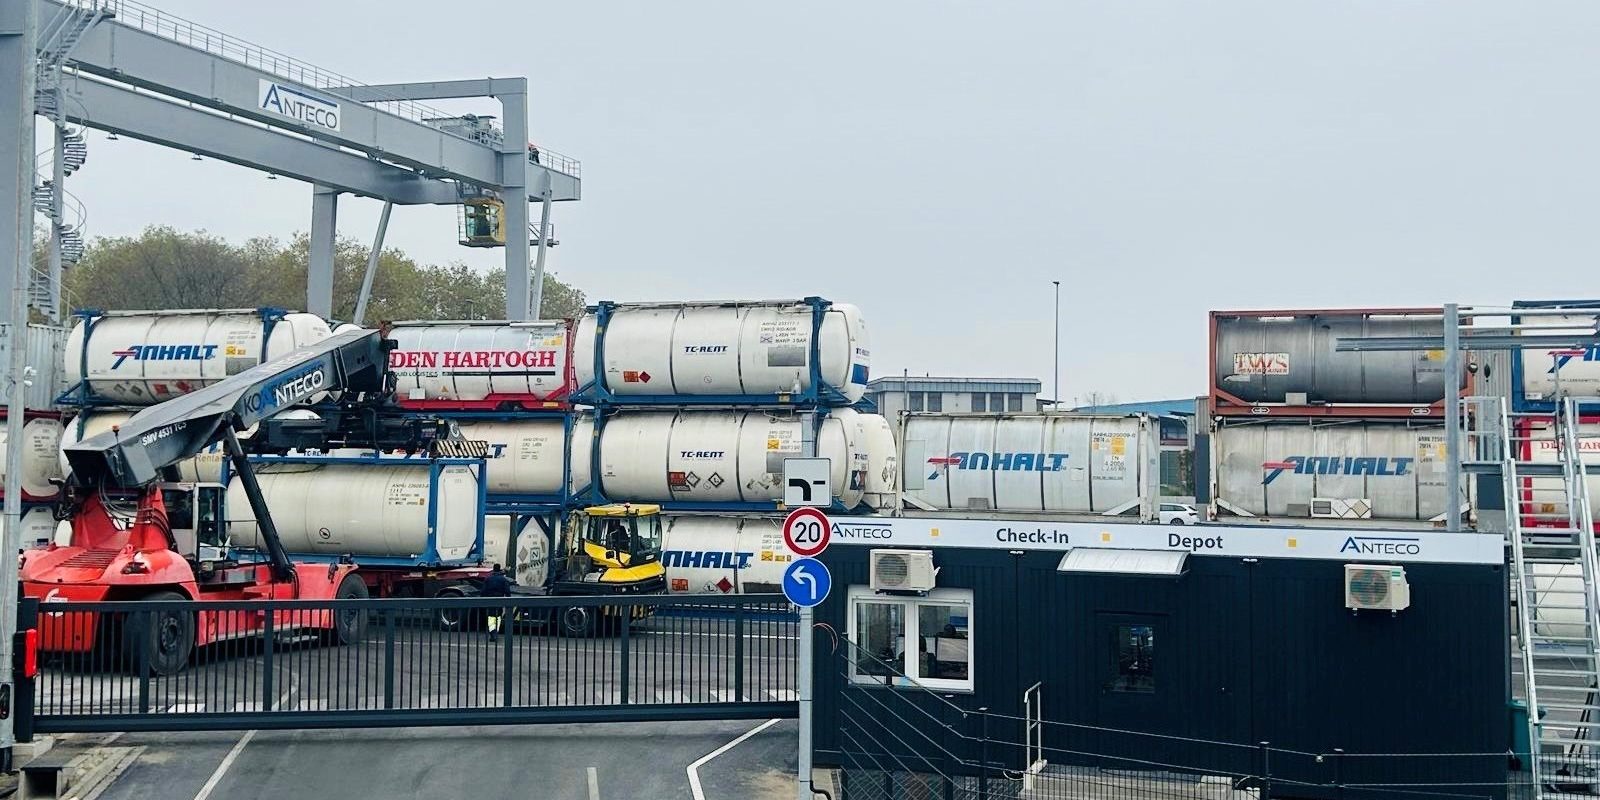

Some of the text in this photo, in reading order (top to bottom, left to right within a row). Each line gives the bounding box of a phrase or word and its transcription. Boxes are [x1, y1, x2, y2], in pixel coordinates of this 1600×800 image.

[262, 84, 337, 129] ANTECO
[111, 344, 218, 370] ANHALT
[391, 350, 556, 369] DEN HARTOGH
[685, 345, 728, 353] TC-RENT
[142, 431, 158, 447] SMV
[158, 426, 173, 439] 4531
[926, 452, 1069, 481] ANHALT
[1261, 455, 1414, 485] ANHALT
[794, 521, 821, 543] 20
[830, 522, 893, 539] ANTECO
[996, 527, 1069, 545] Check-In
[1168, 532, 1224, 552] Depot
[1339, 535, 1421, 556] ANTECO
[661, 550, 754, 570] NHALT
